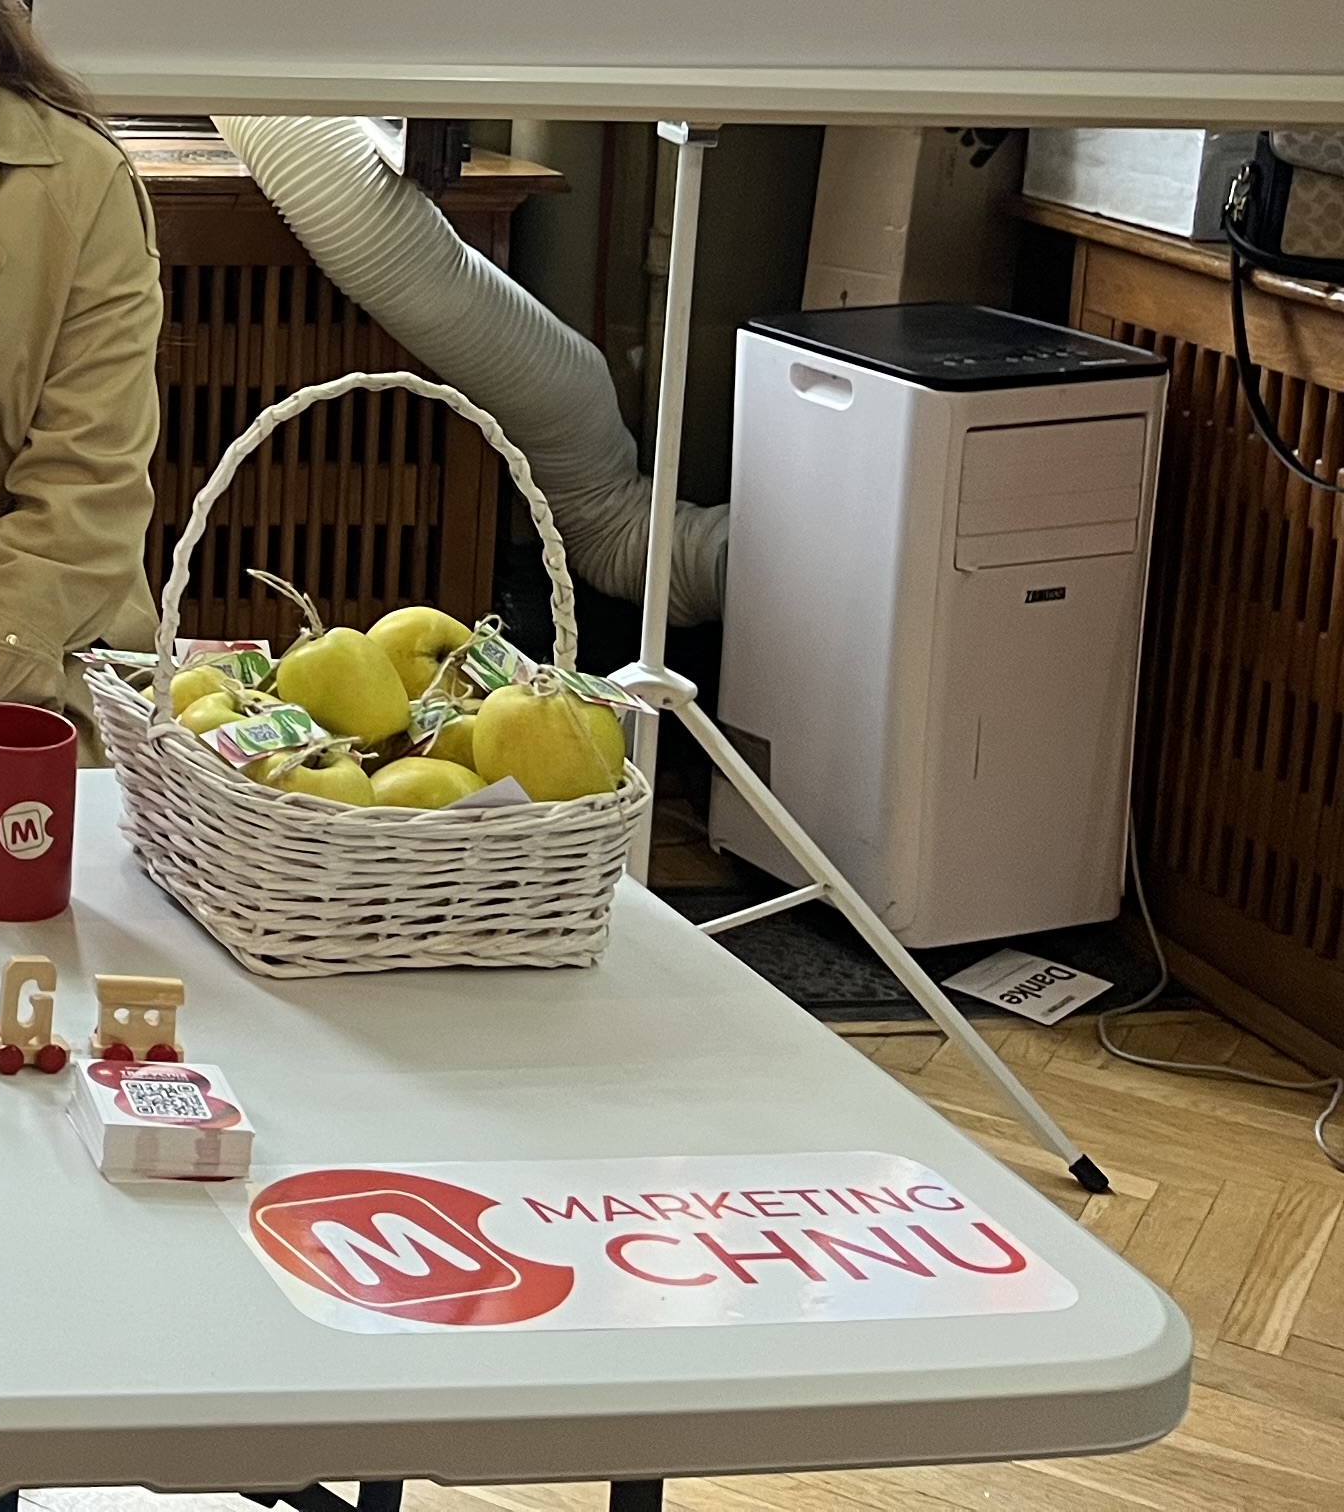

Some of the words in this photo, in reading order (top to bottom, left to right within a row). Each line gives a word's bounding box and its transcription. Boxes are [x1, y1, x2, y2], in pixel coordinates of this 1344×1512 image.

[12, 819, 38, 845] M
[999, 965, 1078, 1005] Danke
[523, 1185, 966, 1224] MARKETING
[310, 1219, 483, 1287] M
[604, 1220, 1028, 1288] CHNU
